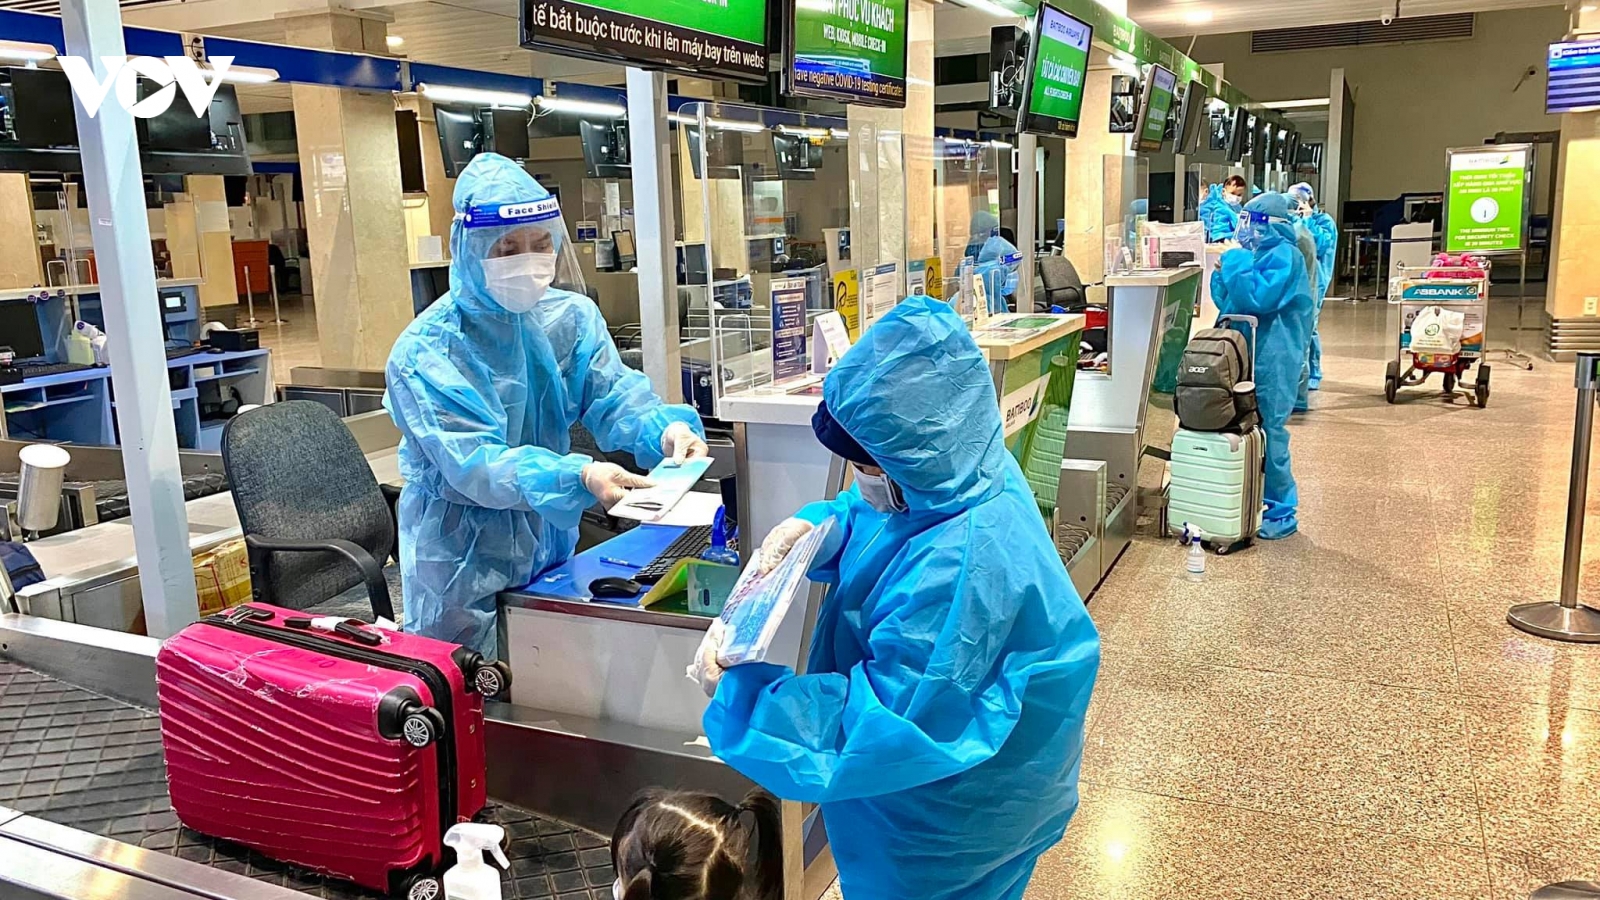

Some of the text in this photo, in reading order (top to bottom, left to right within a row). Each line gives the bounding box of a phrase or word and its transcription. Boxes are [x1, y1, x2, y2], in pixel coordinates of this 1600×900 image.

[871, 0, 895, 33] KHÁCH
[533, 3, 765, 69] tế bắt buộc trước khi lên máy bay trên webs
[823, 24, 836, 44] WEB,
[836, 27, 851, 48] KIOSK,
[851, 31, 868, 49] MOBILE
[808, 70, 835, 88] negative
[834, 72, 862, 91] COVID-19
[861, 78, 879, 96] testing
[507, 207, 533, 216] Face
[537, 200, 557, 212] Shield
[1188, 366, 1209, 374] acer
